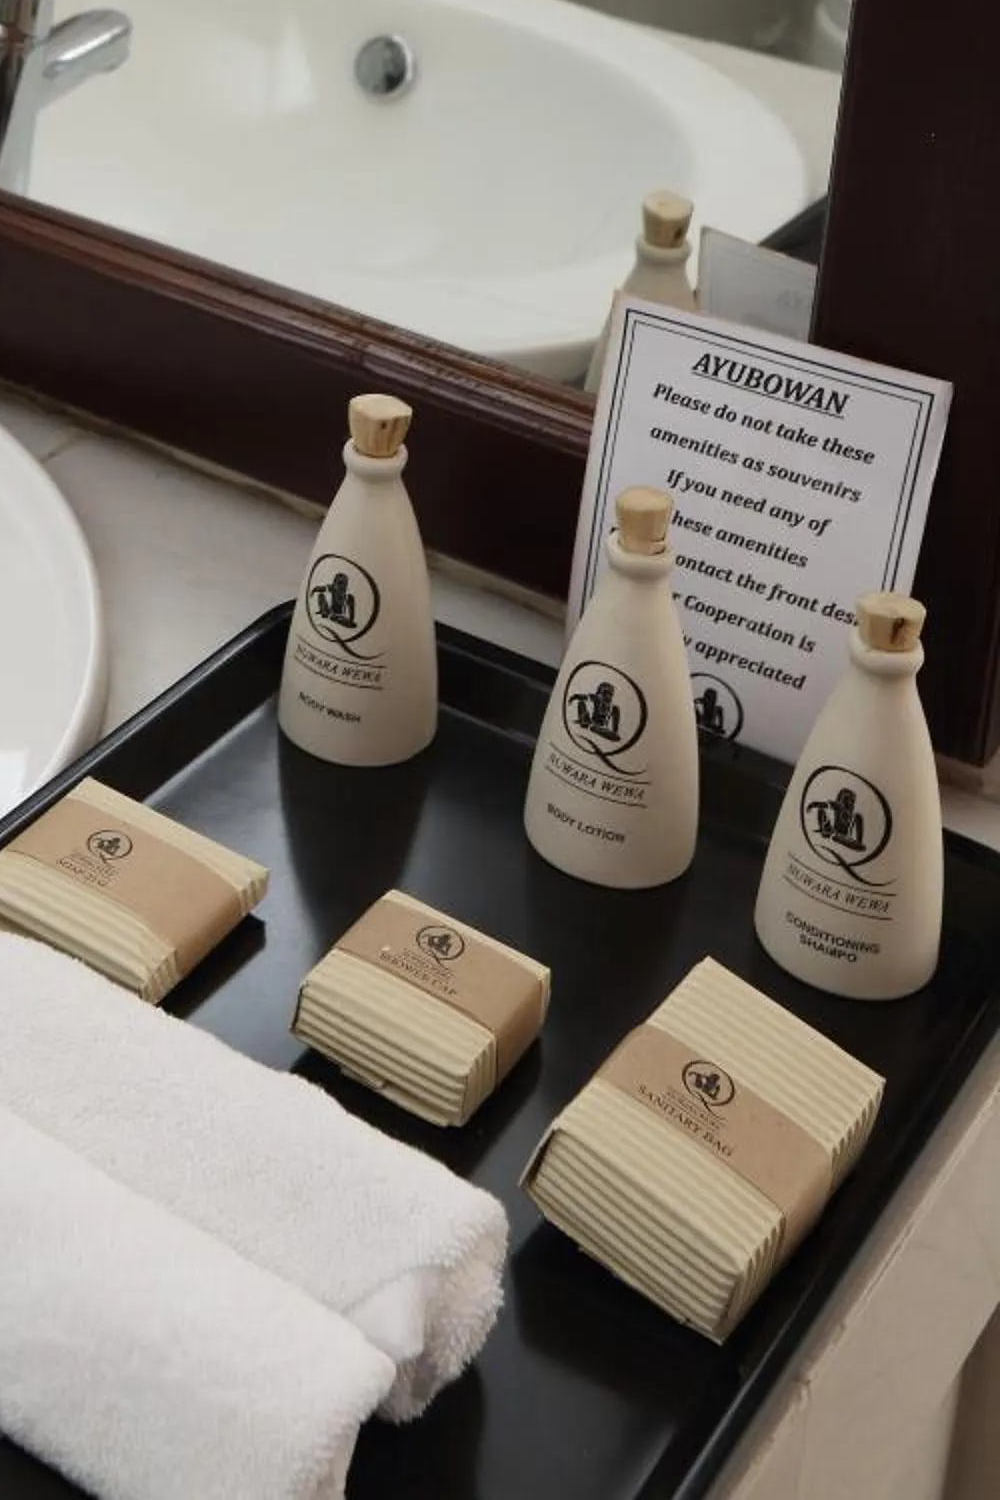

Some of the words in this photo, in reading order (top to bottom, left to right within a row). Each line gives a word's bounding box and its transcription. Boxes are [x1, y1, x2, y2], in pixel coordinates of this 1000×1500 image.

[692, 353, 850, 416] AYUBOWAN
[653, 383, 711, 414] Please
[714, 404, 737, 423] do
[741, 413, 774, 434] not
[776, 423, 819, 447] take
[822, 436, 876, 465] these
[650, 427, 739, 465] amenities
[742, 456, 765, 472] as
[766, 464, 863, 502] souvenirs
[666, 469, 685, 488] If
[680, 477, 717, 498] you
[721, 489, 767, 514] need
[770, 504, 806, 528] any
[808, 517, 832, 536] of
[672, 510, 713, 536] hese
[715, 529, 809, 568] amenities
[675, 554, 735, 583] ontact
[735, 573, 767, 595] the
[766, 584, 819, 612] front
[821, 602, 859, 626] des
[684, 595, 795, 646] Cooperation
[799, 635, 817, 653] is
[695, 639, 807, 690] appreciated
[547, 803, 576, 827] BODY
[577, 820, 625, 844] LOTION
[785, 910, 881, 955] CONDITIONING
[638, 1085, 702, 1133] SANITARY
